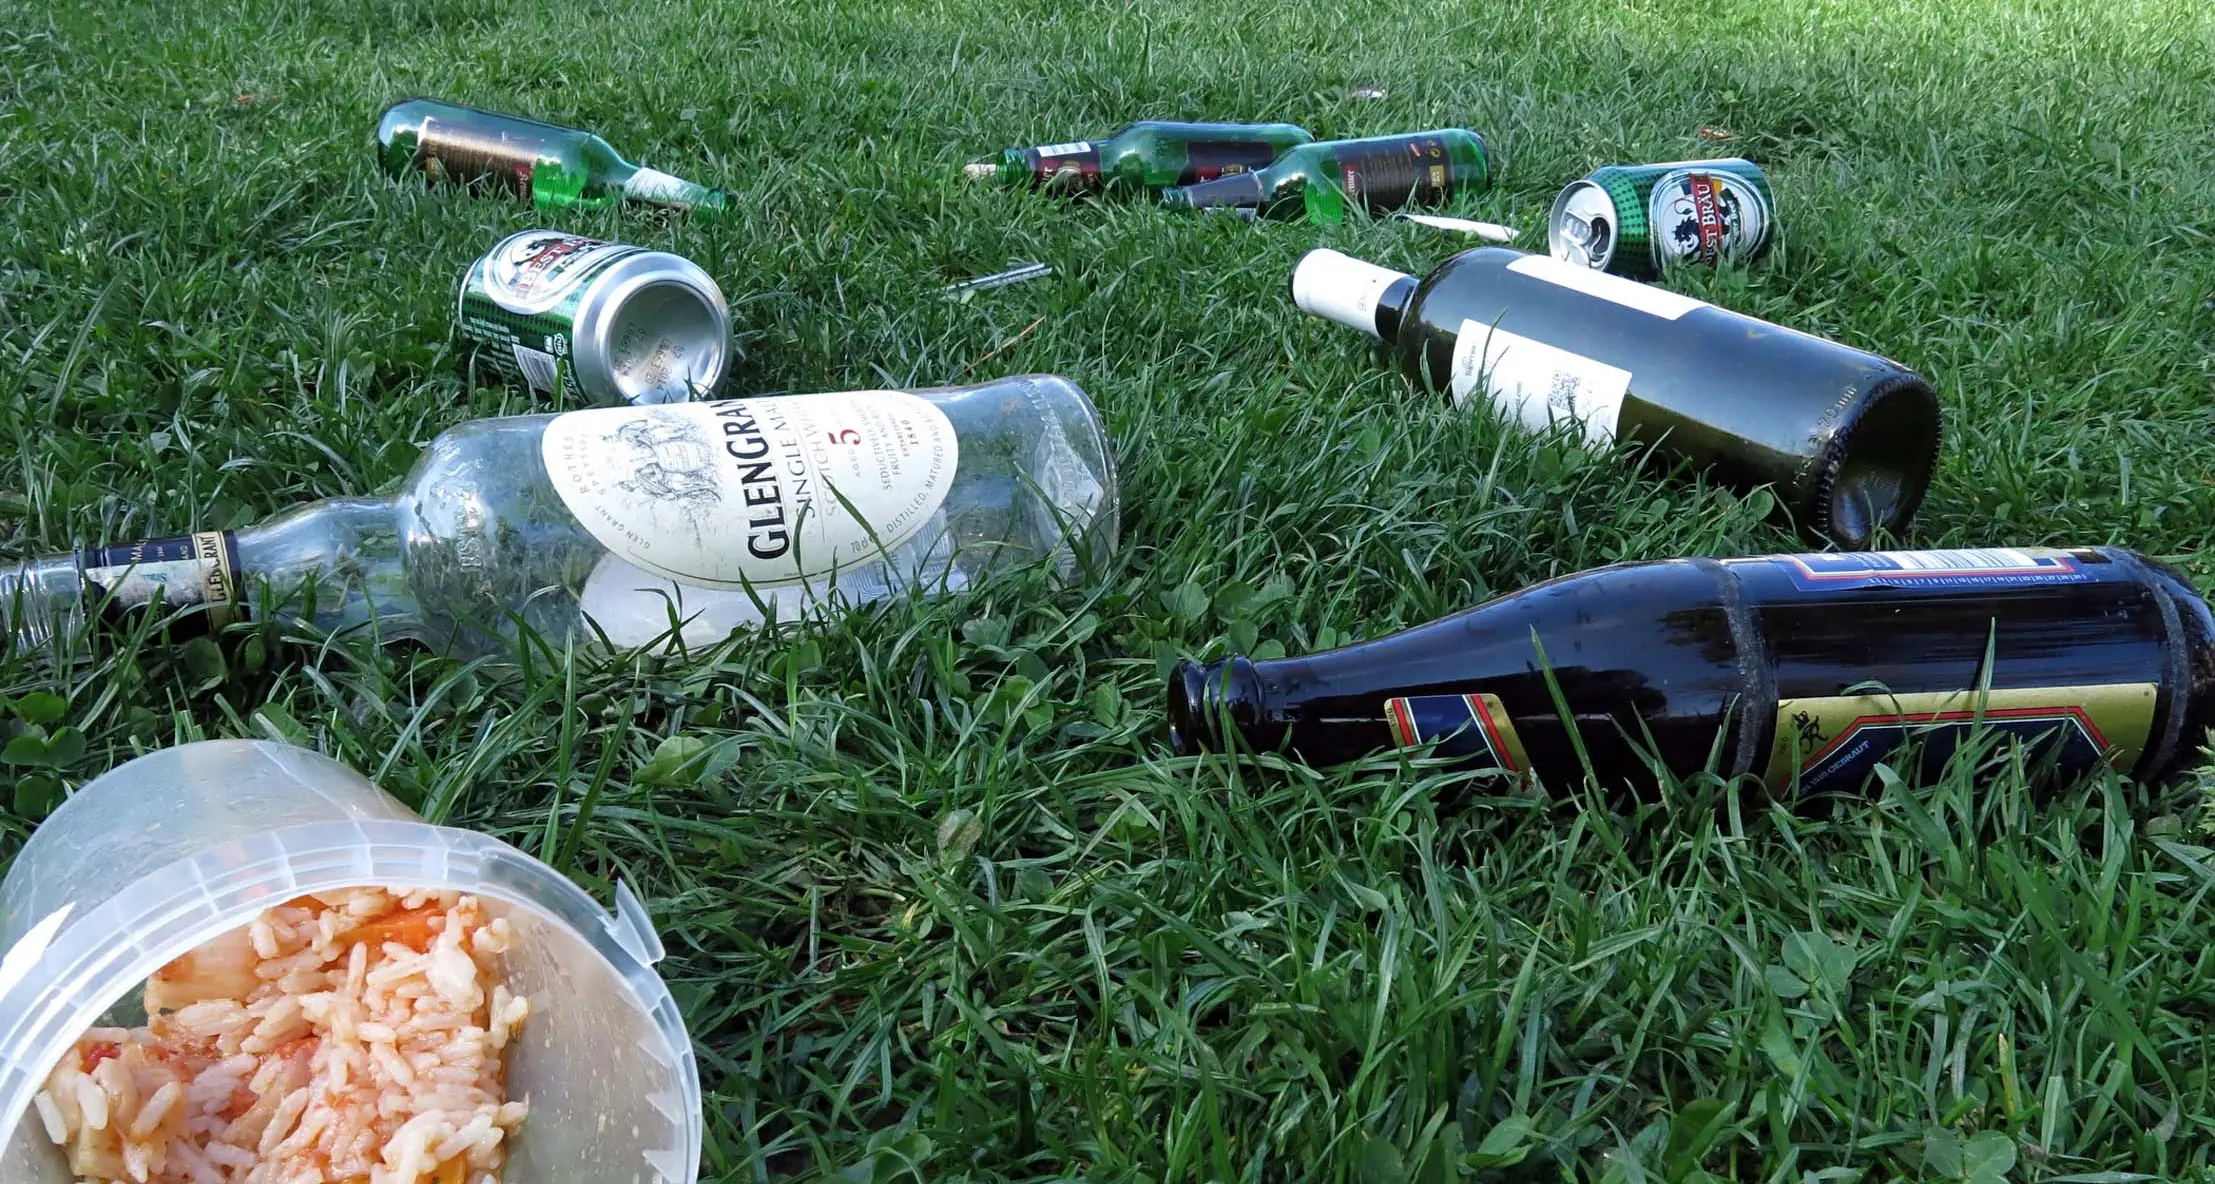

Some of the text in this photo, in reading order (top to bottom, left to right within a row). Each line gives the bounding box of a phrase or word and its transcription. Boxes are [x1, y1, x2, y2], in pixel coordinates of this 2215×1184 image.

[1697, 184, 1717, 226] BRÄU
[519, 246, 562, 284] BEST
[827, 428, 861, 447] 5
[883, 440, 902, 476] FRUITY
[562, 435, 590, 494] ROTHES
[779, 437, 816, 518] SINGLE
[885, 491, 930, 533] DISTILLED,
[924, 444, 945, 490] MATURED
[594, 504, 650, 550] GLEN GRANT
[1827, 740, 1870, 774] GEBRAUT
